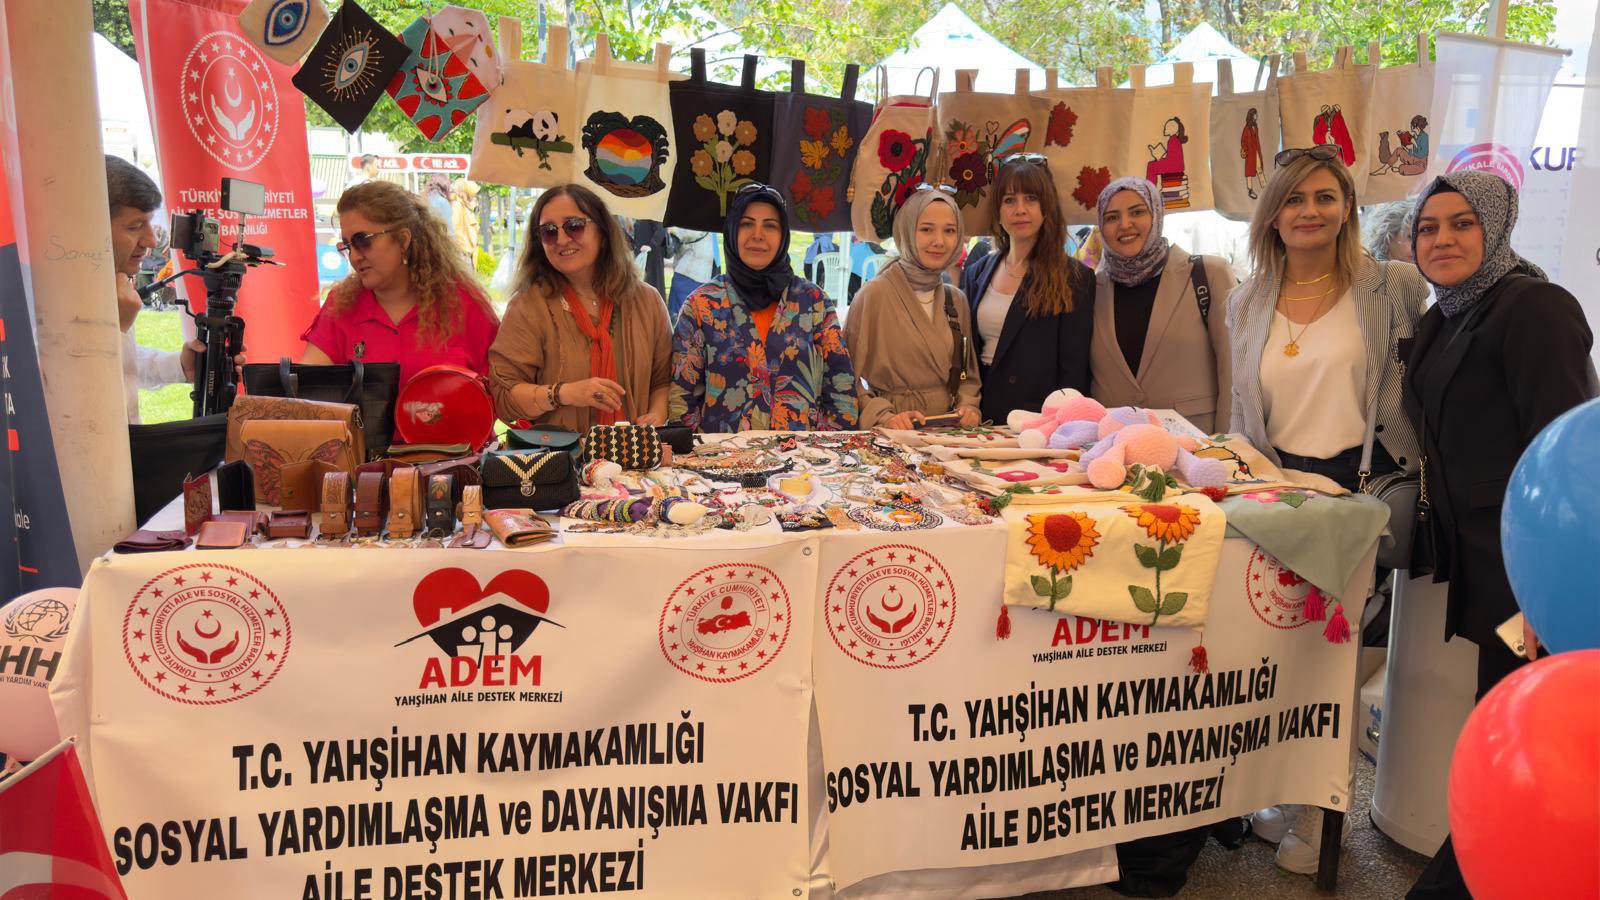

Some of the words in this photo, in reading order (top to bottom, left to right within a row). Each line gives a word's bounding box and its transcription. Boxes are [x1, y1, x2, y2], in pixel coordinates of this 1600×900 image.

[179, 188, 222, 203] TÜRKİ
[264, 189, 295, 204] RİYETİ
[221, 222, 268, 236] BAANLIĞI
[174, 591, 193, 605] AİLE
[193, 589, 206, 598] VE
[207, 589, 240, 607] SOSYAL
[686, 589, 717, 622] TÜRKİYE
[719, 584, 767, 613] CUMHURİYETİ
[865, 571, 881, 583] AİLE
[881, 567, 892, 575] VE
[892, 567, 919, 581] SOSYAL
[918, 577, 934, 617] HİZMETLER
[154, 603, 175, 654] CUMHURİYETİ
[240, 603, 262, 647] HİZMETLER
[1051, 616, 1150, 647] ADEM
[0, 645, 62, 682] HH
[163, 654, 198, 678] TÜRKİYE
[220, 647, 259, 678] BAKANLIĞI
[1032, 650, 1073, 663] YAHŞİHAN
[1076, 647, 1094, 659] AİLE
[1097, 645, 1128, 656] DESTEK
[1131, 641, 1168, 654] MERKEZİ
[33, 681, 49, 689] VAK
[418, 655, 542, 689] ADEM
[394, 692, 447, 708] YAHŞİHAN
[451, 691, 474, 703] AİLE
[477, 691, 515, 702] DESTEK
[519, 691, 563, 703] MERKEZİ
[908, 702, 956, 742] T.C.
[964, 681, 1088, 742] YAHŞİHAN
[1096, 656, 1278, 720] KAYMAKAMLIĞI
[232, 743, 292, 791] T.C.
[303, 726, 466, 792] YAHŞİHAN
[477, 710, 705, 773] KAYMAKAMLIĞI
[826, 761, 920, 814] SOSYAL
[928, 739, 1106, 797] YARDIMLAŞMA
[1113, 741, 1139, 773] ve
[1146, 715, 1271, 766] DAYANIŞMA
[1277, 703, 1341, 744] VAKFI
[960, 802, 1018, 851] AİLE
[1026, 790, 1117, 844] DESTEK
[1123, 766, 1226, 826] MERKEZİ
[113, 815, 248, 876] SOSYAL
[257, 794, 490, 854] YARDIMLAŞMA
[498, 800, 532, 836] ve
[541, 784, 708, 839] DAYANIŞMA
[716, 782, 798, 824] VAKFI
[301, 860, 373, 900] AİLE
[384, 858, 504, 900] DESTEK
[513, 838, 644, 898] MERKEZİ
